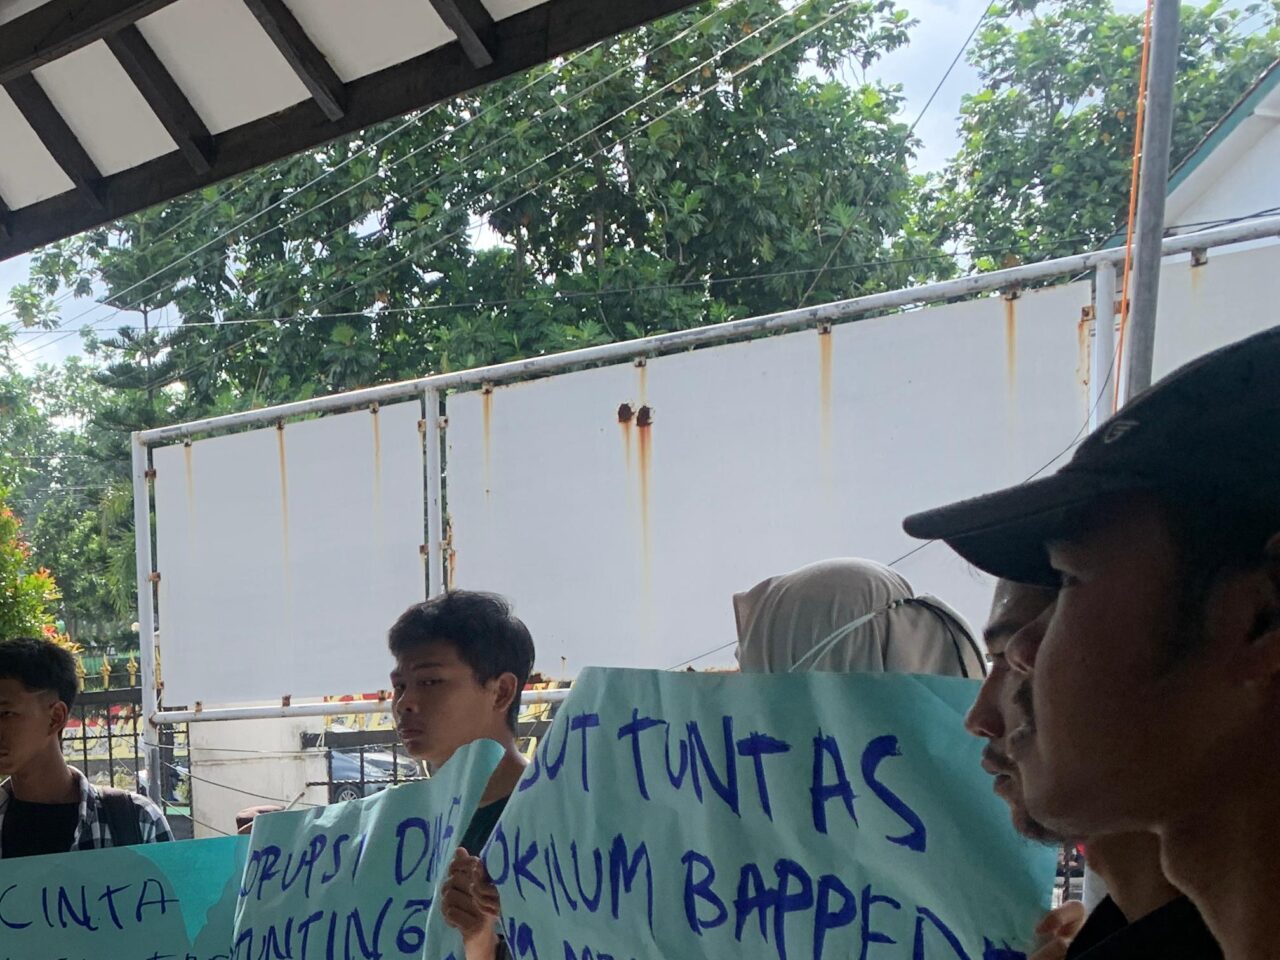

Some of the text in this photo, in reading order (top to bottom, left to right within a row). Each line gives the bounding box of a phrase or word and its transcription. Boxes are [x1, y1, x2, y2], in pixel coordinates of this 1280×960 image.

[618, 708, 927, 852] TUNTAS
[239, 833, 368, 900] ORUPSI
[483, 822, 656, 940] OKNUM
